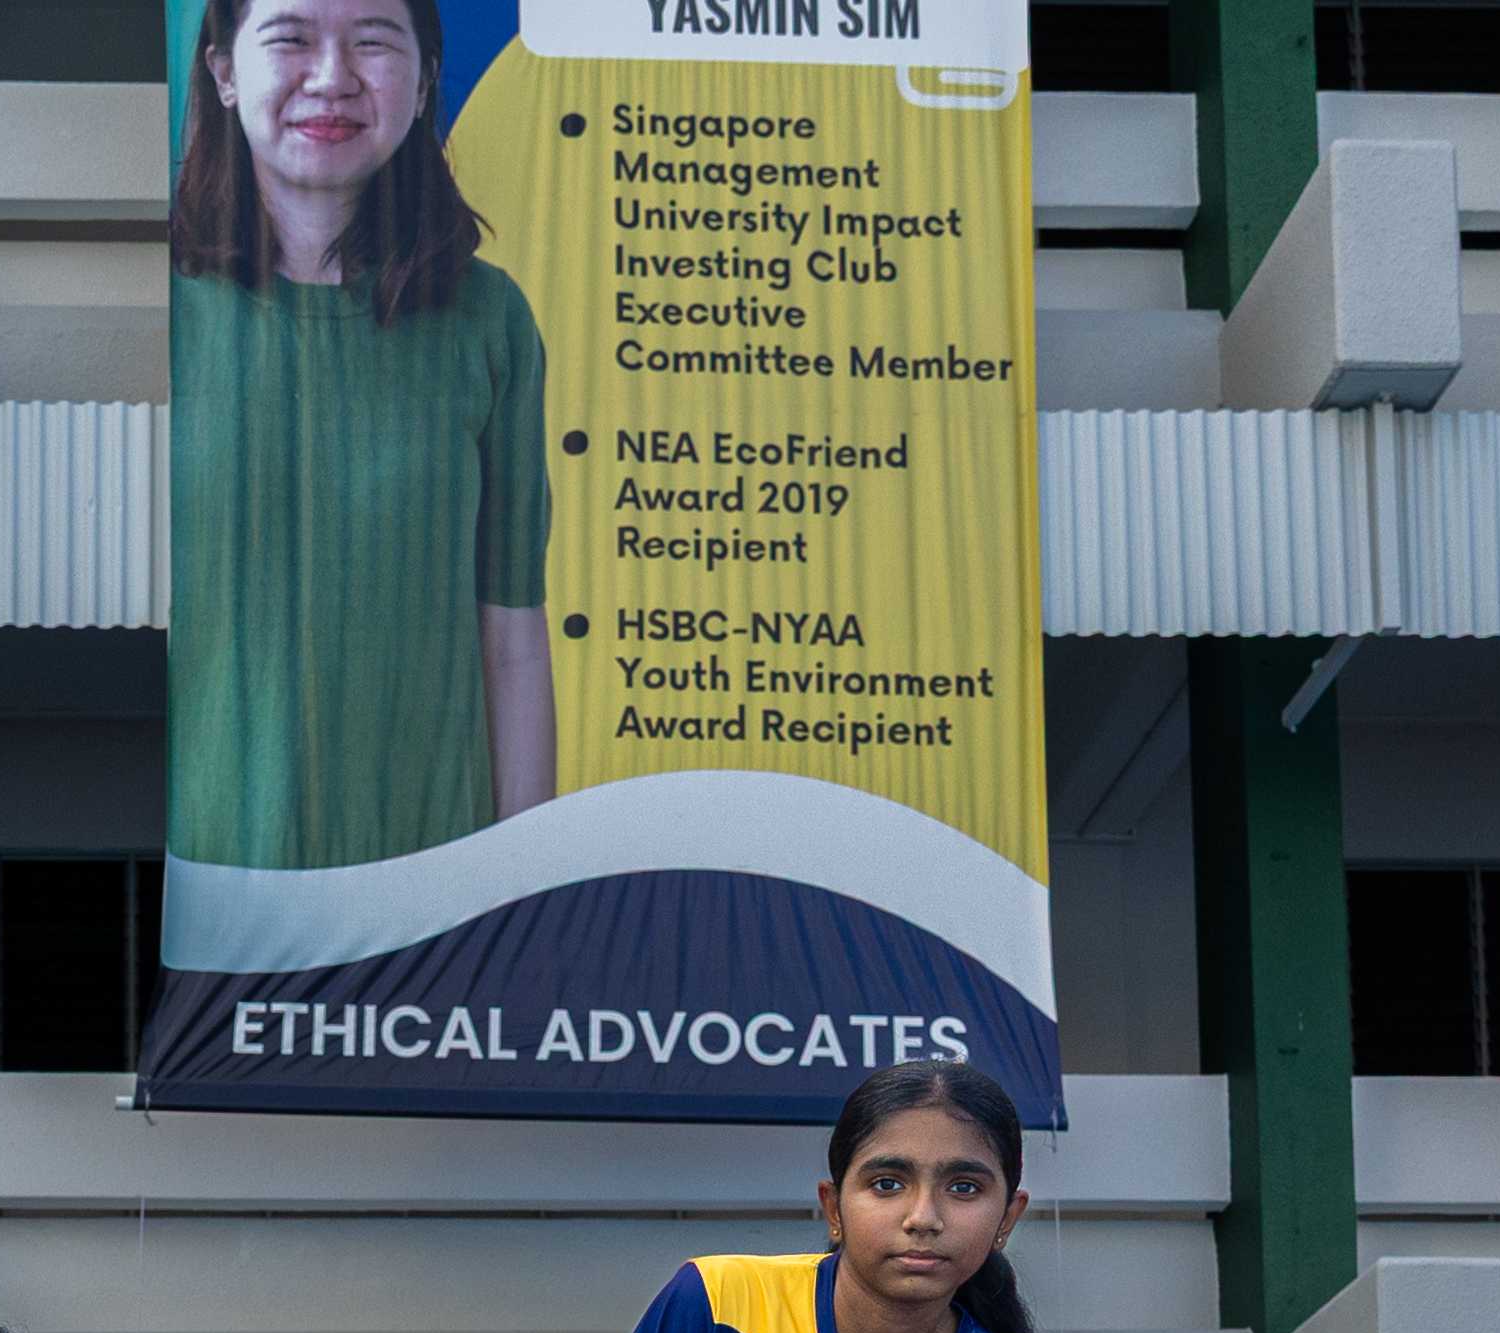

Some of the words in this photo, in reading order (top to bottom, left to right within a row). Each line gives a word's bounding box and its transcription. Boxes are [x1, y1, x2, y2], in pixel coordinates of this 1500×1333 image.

[647, 0, 819, 37] YASMIN
[837, 0, 920, 40] SIM
[613, 103, 816, 149] Singapore
[614, 149, 880, 197] Management
[614, 196, 810, 247] University
[823, 204, 963, 253] Impact
[615, 243, 792, 292] Investing
[806, 242, 898, 285] Club
[615, 291, 807, 330] Executive
[615, 339, 835, 378] Committee
[849, 344, 1014, 382] Member
[617, 429, 700, 464] NEA
[713, 431, 909, 470] EcoFriend
[614, 475, 745, 513] Award
[758, 481, 849, 517] 2019
[617, 525, 808, 572] Recipient
[617, 608, 866, 648] HSBC-NYAA
[615, 654, 730, 692] Youth
[746, 659, 994, 699] Environment
[615, 703, 747, 741] Award
[762, 709, 952, 756] Recipient
[232, 1001, 518, 1060] ETHICAL
[535, 1008, 969, 1068] ADVOCATES
